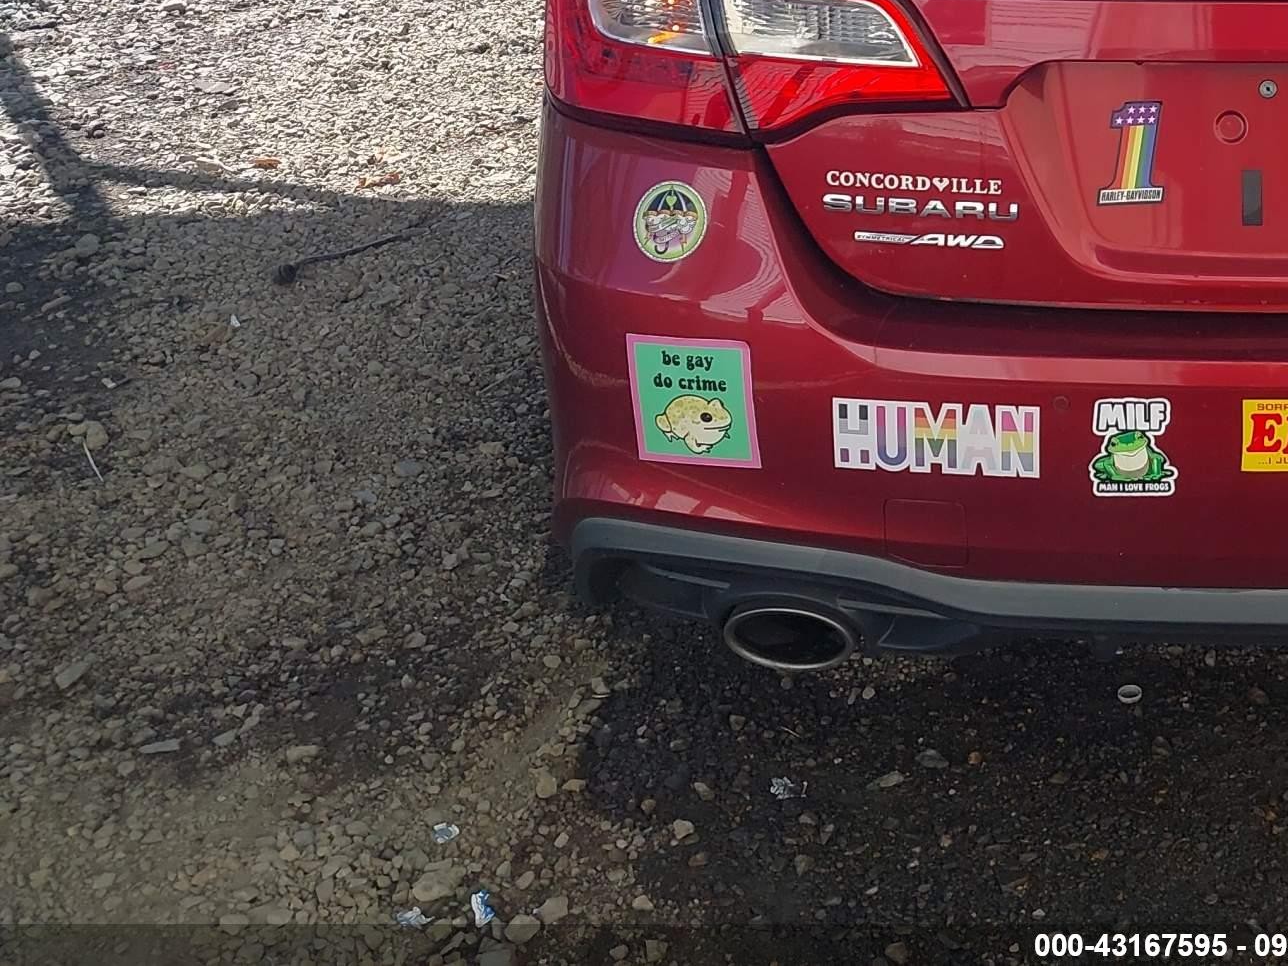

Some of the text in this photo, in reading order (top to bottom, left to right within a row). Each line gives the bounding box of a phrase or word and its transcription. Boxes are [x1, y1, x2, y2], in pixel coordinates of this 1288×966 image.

[822, 193, 1020, 221] SUBARU
[856, 234, 1004, 249] SYMMETRICAL AWD
[661, 350, 714, 371] be gay
[653, 373, 727, 392] do crime
[1097, 402, 1166, 430] MILF
[837, 401, 1035, 473] HUMAN
[1099, 482, 1170, 492] MAN I LOVE FROGS
